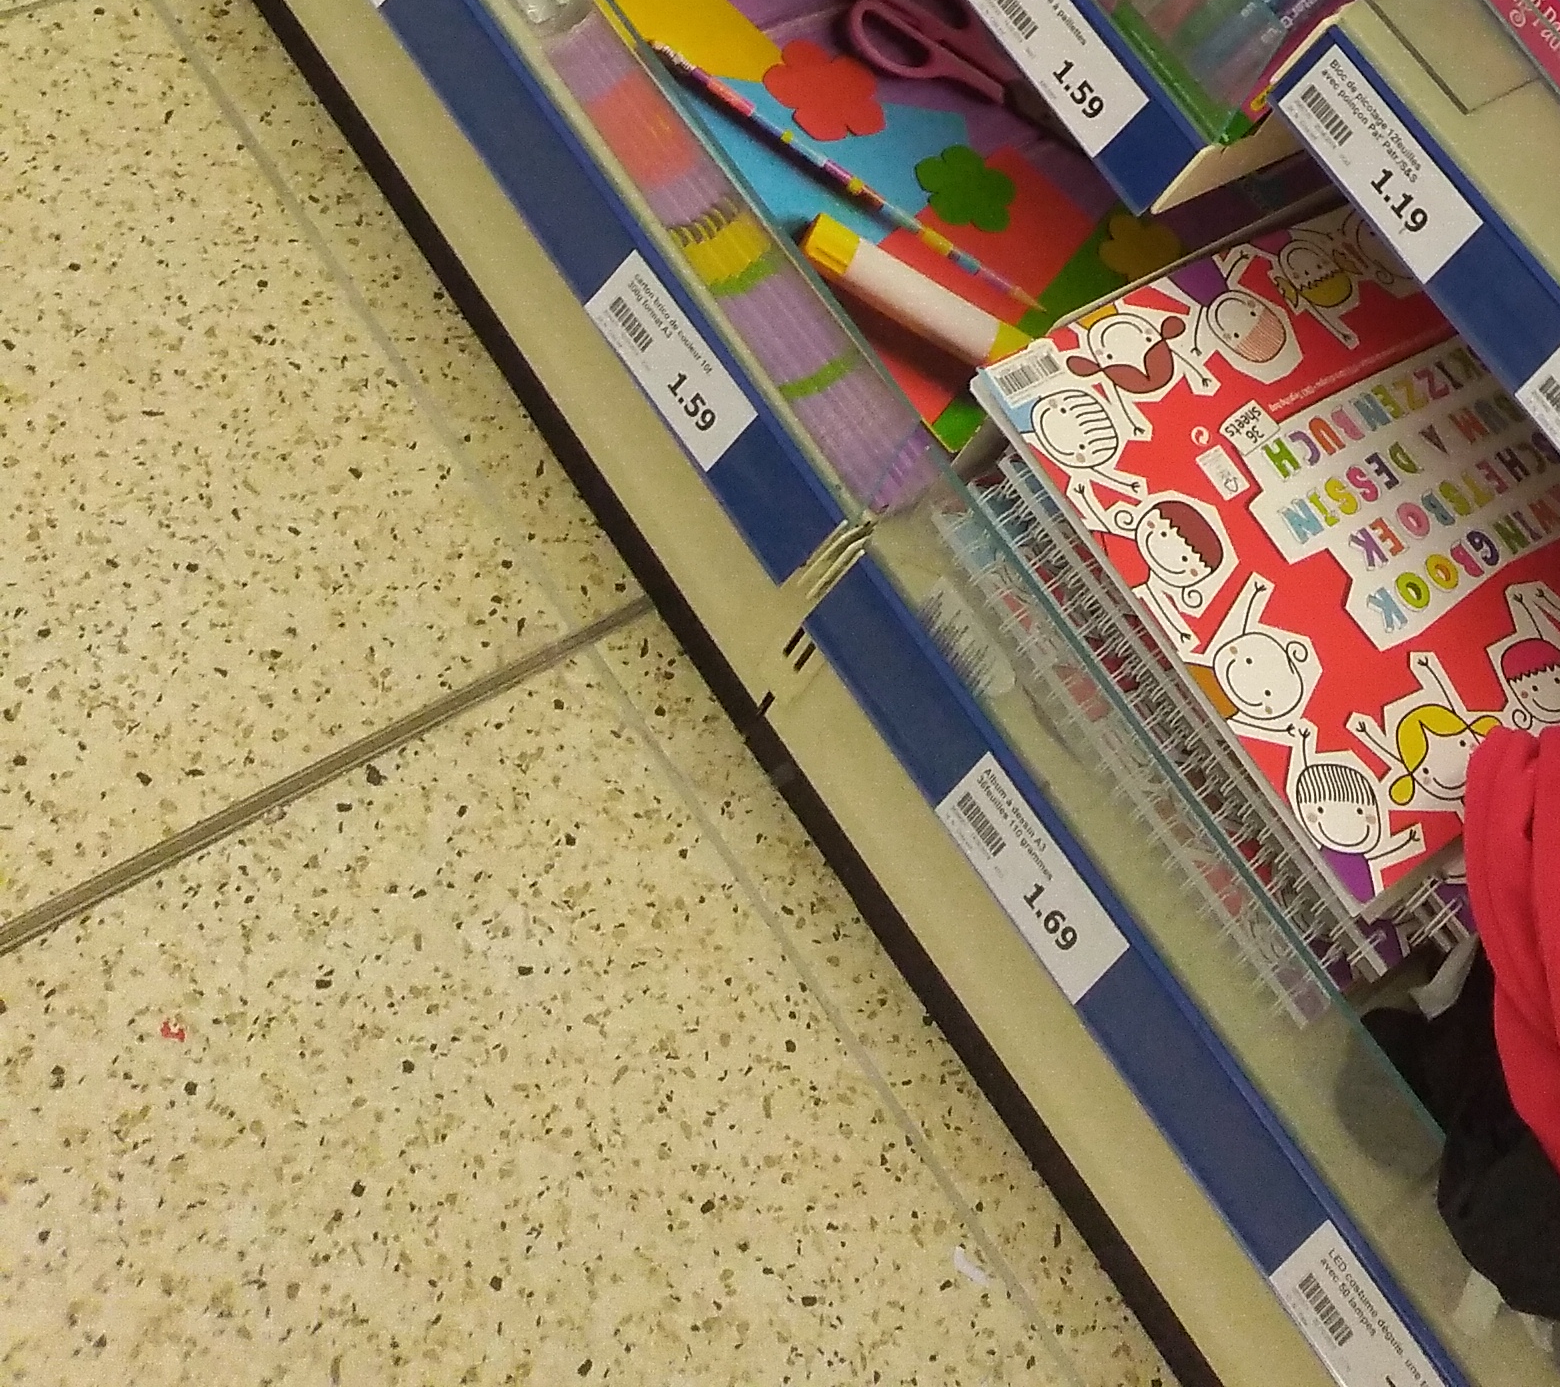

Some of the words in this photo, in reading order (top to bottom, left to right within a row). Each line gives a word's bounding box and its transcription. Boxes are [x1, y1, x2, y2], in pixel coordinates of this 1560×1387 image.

[1052, 1, 1061, 11] à
[1056, 8, 1089, 48] paillettes
[1052, 57, 1105, 122] 1.59
[1320, 67, 1339, 89] avec
[1336, 88, 1370, 127] poinçon
[1328, 58, 1349, 82] Bloc
[1345, 79, 1359, 94] de
[1354, 91, 1389, 132] picotage
[1386, 128, 1423, 172] 12feuilles
[1368, 165, 1430, 236] 1.19
[633, 271, 655, 300] carton
[652, 297, 671, 321] brico
[668, 318, 680, 332] de
[676, 329, 702, 362] couleur
[641, 298, 664, 328] format
[661, 324, 673, 339] A3
[667, 369, 717, 435] 1.59
[1218, 403, 1265, 443] sheets
[1242, 423, 1265, 446] 36
[1415, 422, 1449, 464] A
[1273, 436, 1424, 548] DESSIN
[975, 775, 1010, 821] 36feuilles
[1007, 819, 1023, 839] 110
[1018, 837, 1054, 884] grammes
[983, 766, 1009, 800] Album
[1005, 796, 1014, 807] à
[1011, 804, 1037, 838] dessin
[1033, 835, 1048, 854] A3
[1023, 879, 1078, 956] 1.69
[1319, 1255, 1340, 1284] avec
[1337, 1281, 1351, 1298] 50
[1347, 1295, 1377, 1338] lampes
[1327, 1246, 1348, 1274] LED
[1344, 1270, 1379, 1320] costume
[1375, 1316, 1406, 1360] déguis.
[1403, 1356, 1422, 1381] une
